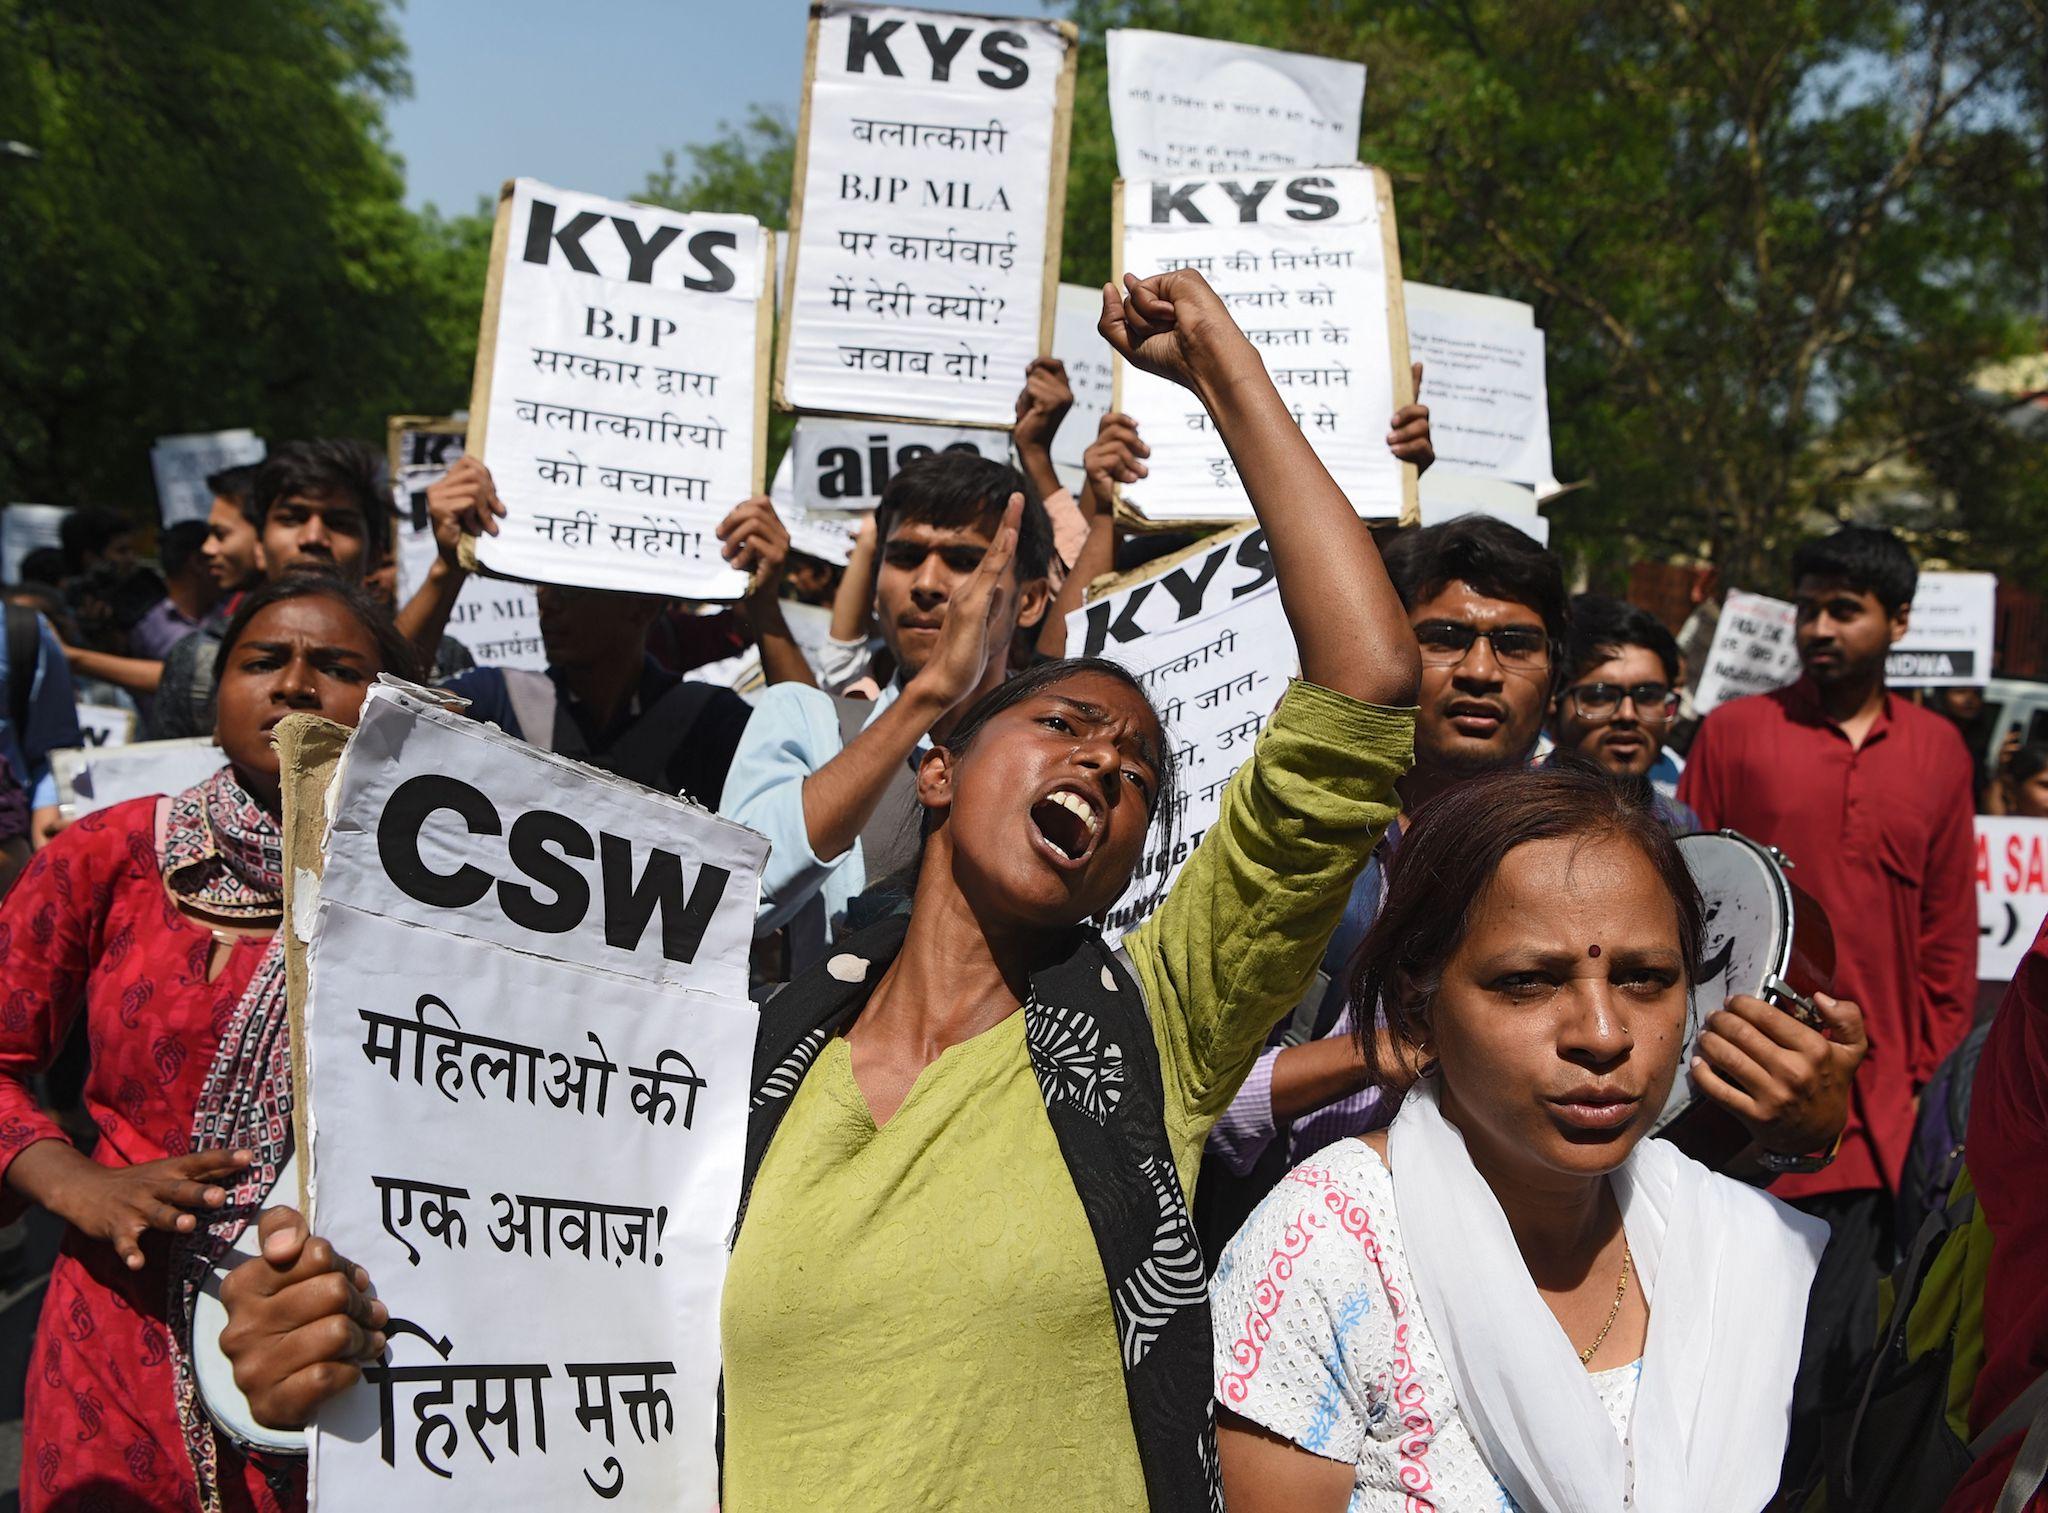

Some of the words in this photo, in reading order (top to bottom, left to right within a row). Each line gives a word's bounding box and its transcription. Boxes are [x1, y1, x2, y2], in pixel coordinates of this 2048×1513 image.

[846, 15, 1030, 90] KYS
[851, 118, 1009, 154] बलात्कारी
[840, 174, 908, 202] BJP
[920, 179, 1012, 212] MLA
[1150, 177, 1341, 225] KYS
[523, 199, 738, 294] KYS
[837, 230, 878, 258] पर
[1222, 249, 1264, 273] की
[1269, 246, 1354, 274] निर्भया
[829, 275, 856, 312] में
[864, 278, 916, 320] देरी
[925, 284, 1006, 326] क्यों?
[1295, 282, 1337, 307] को
[584, 306, 678, 348] BJP
[1318, 320, 1351, 346] के
[531, 347, 645, 392] सरकार
[654, 366, 719, 398] द्वारा
[838, 345, 934, 377] जवाब
[942, 342, 989, 383] दो!
[1273, 359, 1352, 388] बचाने
[1312, 403, 1339, 434] से
[536, 451, 588, 487] को
[597, 465, 711, 502] बचाना
[533, 510, 598, 547] नहीं
[1083, 527, 1278, 657] KYS
[376, 773, 731, 966] CSW
[357, 993, 618, 1118] महिलाओ
[628, 1048, 708, 1131] की
[371, 1175, 471, 1267] एक
[487, 1192, 669, 1268] आवाज़!
[565, 1361, 676, 1500] मुक्त
